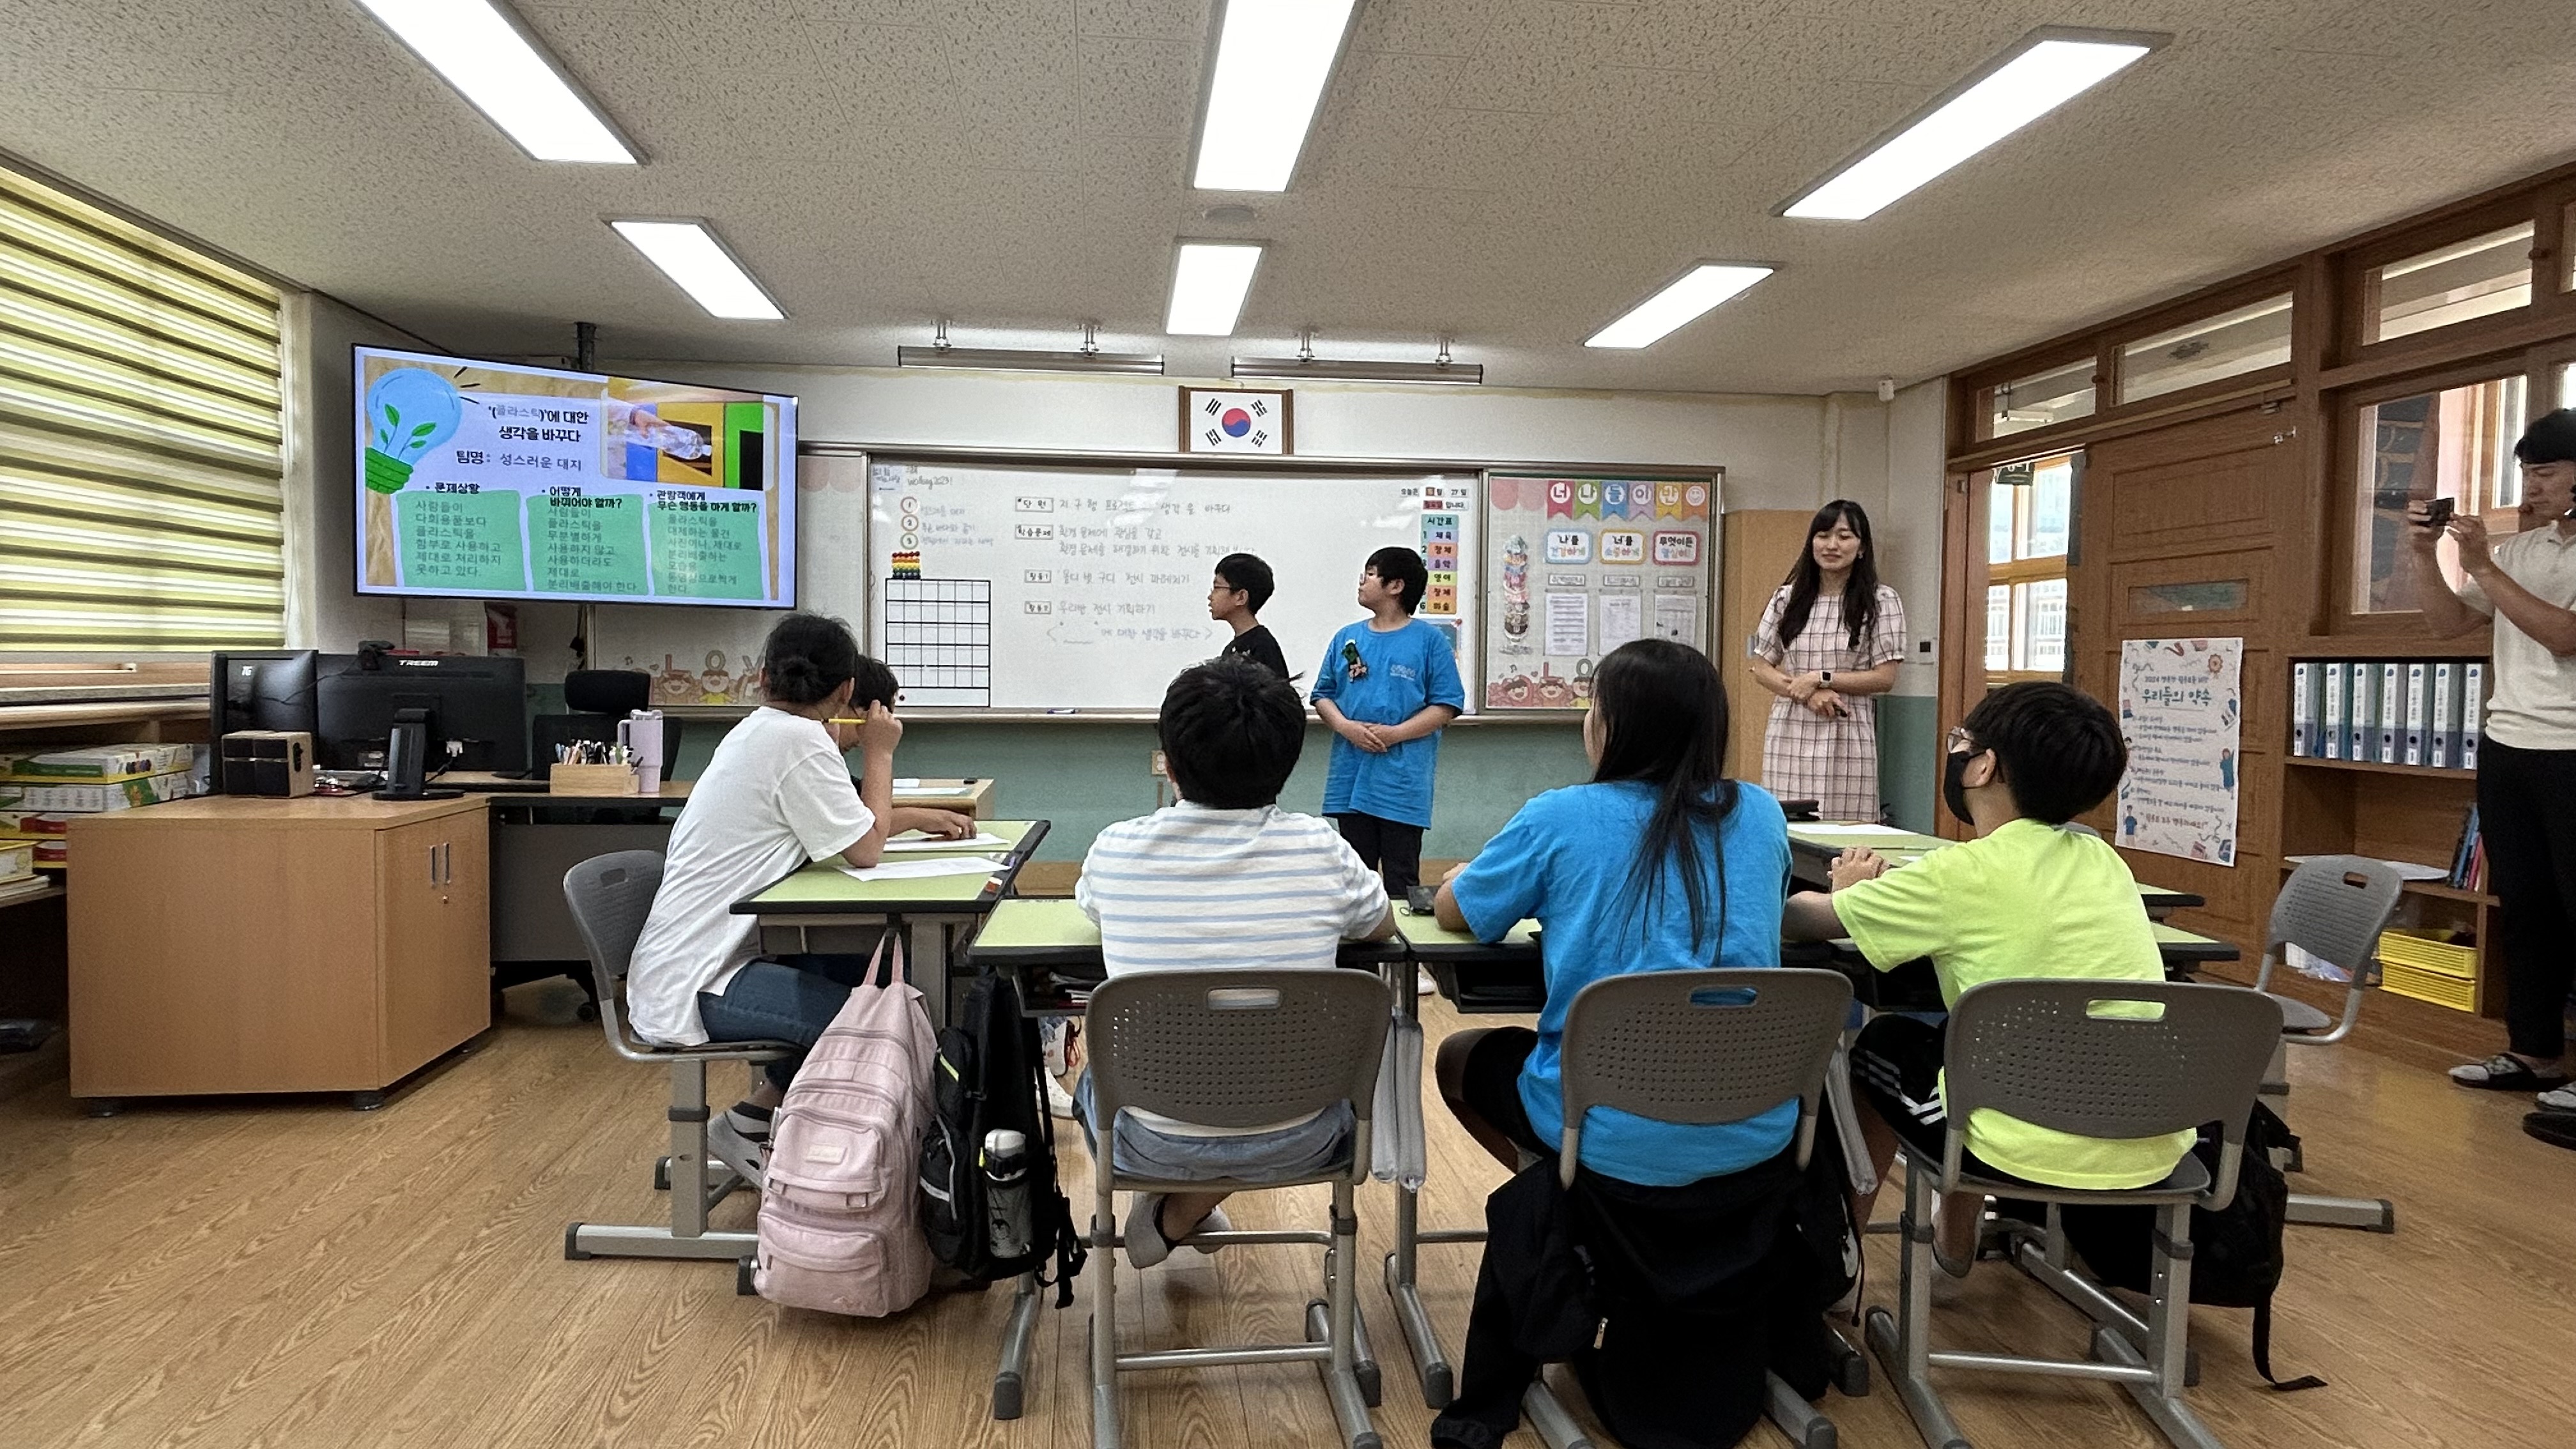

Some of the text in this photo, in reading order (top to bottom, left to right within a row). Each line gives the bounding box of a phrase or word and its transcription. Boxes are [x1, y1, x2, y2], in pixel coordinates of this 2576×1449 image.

[564, 411, 589, 424] 대한
[499, 425, 581, 442] 생각을 바꾸다
[500, 454, 552, 469] 성스러운
[556, 458, 581, 471] 대지
[435, 482, 480, 494] 문제상황
[549, 486, 581, 497] 어떻게
[416, 500, 463, 513] 사람들이
[594, 498, 623, 509] 할까?
[657, 501, 677, 510] 무슨
[710, 503, 730, 512] 하게
[732, 503, 757, 513] 할까?
[1427, 517, 1452, 526] 시간표
[1423, 531, 1427, 539] 1
[416, 539, 501, 552] 함부로 사용하고
[1659, 537, 1693, 548] 무엇이든
[548, 543, 590, 555] 사용하지
[416, 551, 501, 565] 제대로 처리하지
[416, 564, 452, 576] 못하고
[548, 567, 579, 577] 제대로
[1434, 574, 1451, 582] 영어
[2142, 686, 2212, 706] 우리들의 약속
